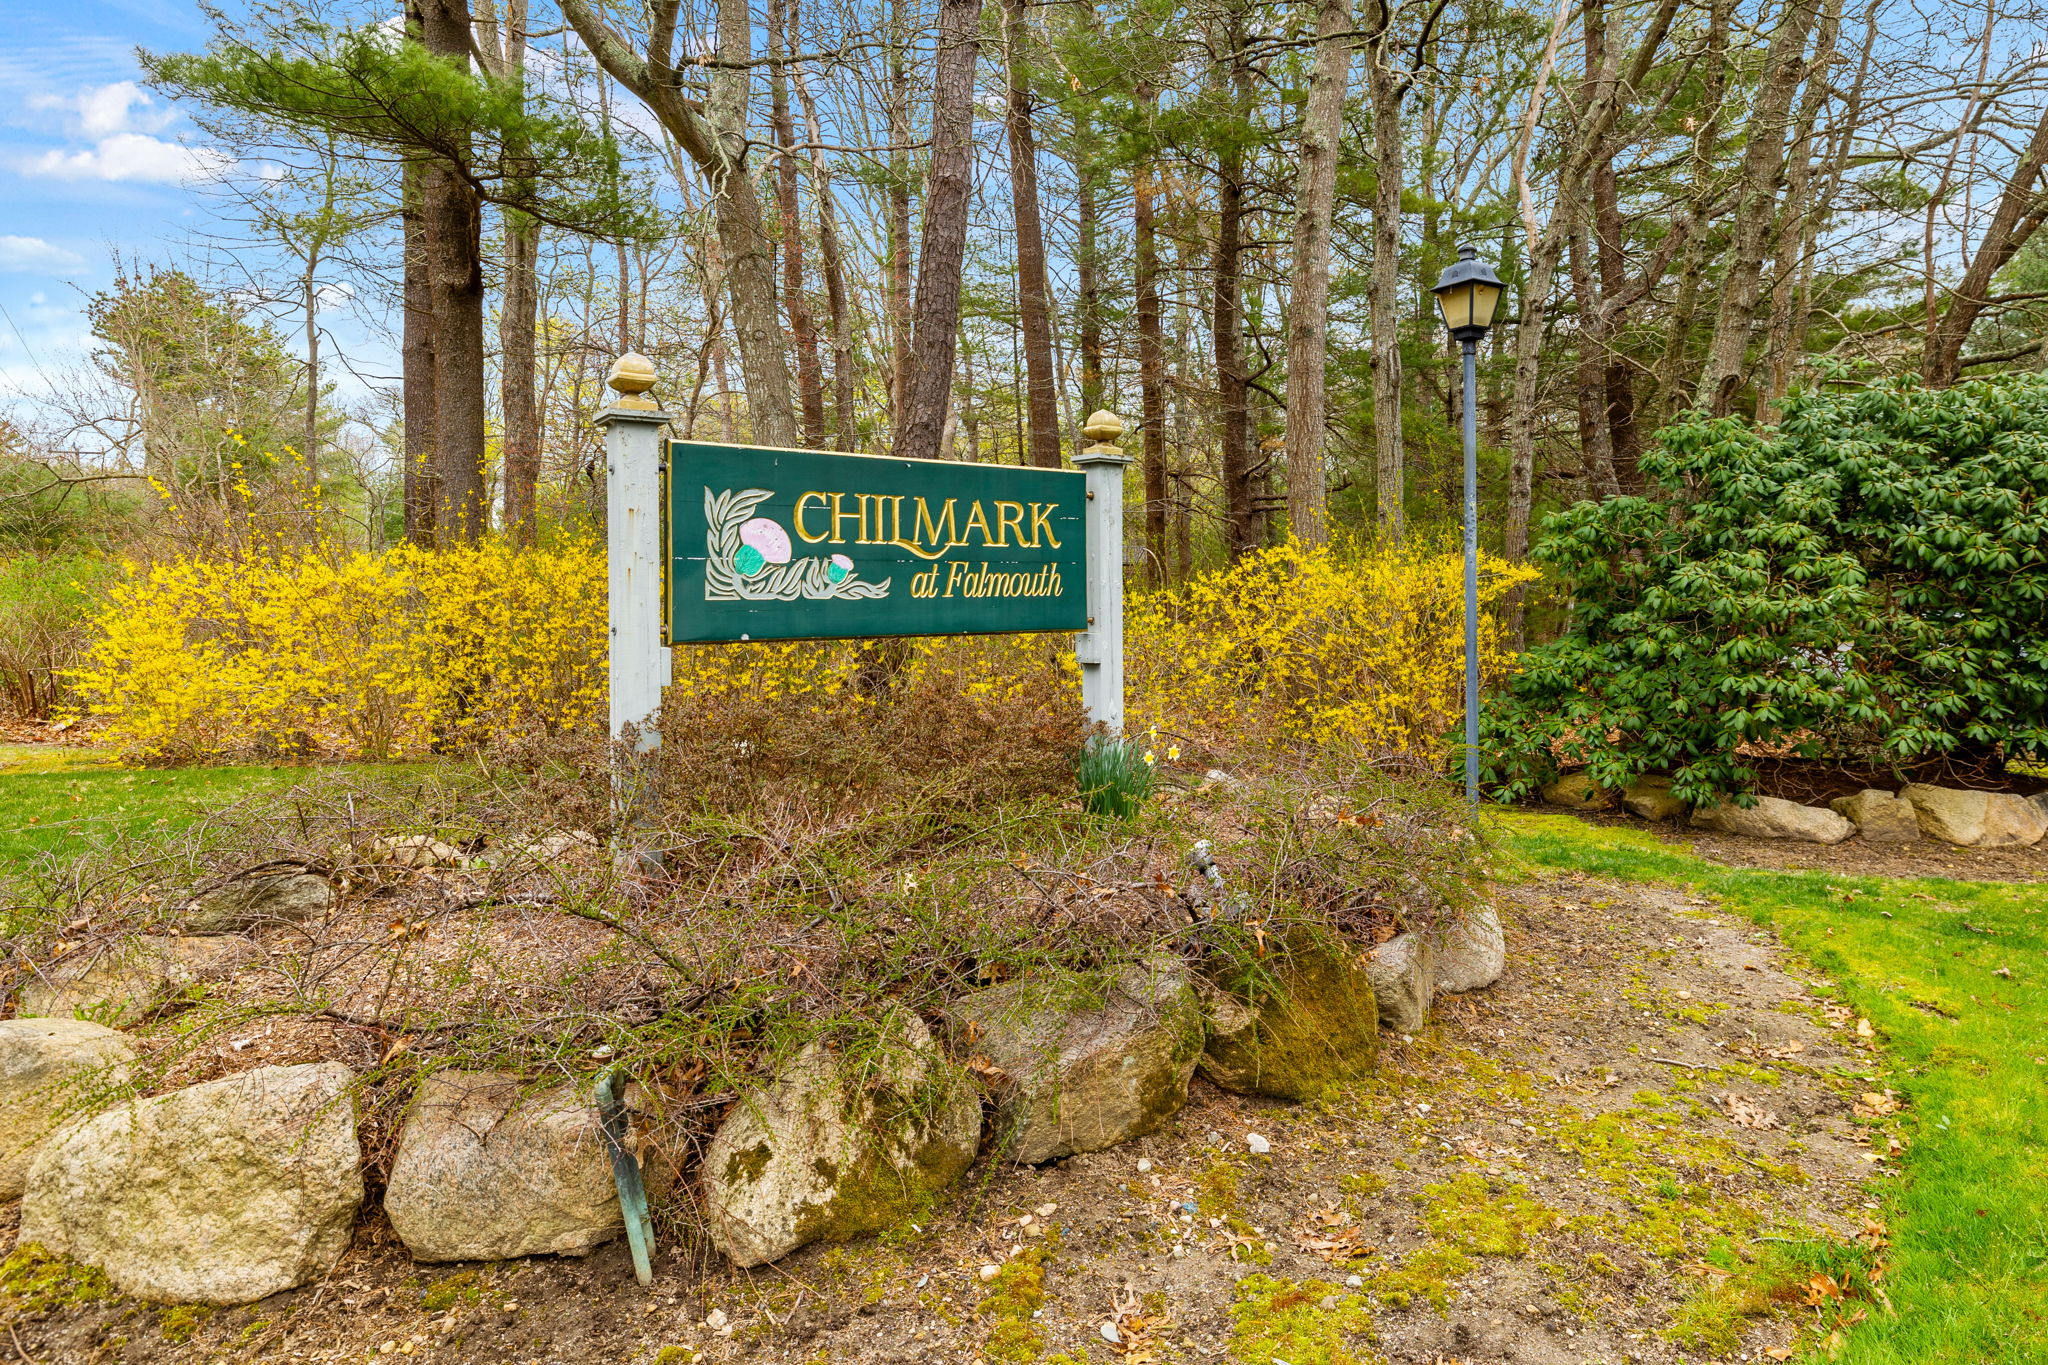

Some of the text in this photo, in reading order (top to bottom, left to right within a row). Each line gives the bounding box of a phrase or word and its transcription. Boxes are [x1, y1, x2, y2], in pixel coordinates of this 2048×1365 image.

[793, 490, 1062, 560] CHILMARK
[910, 561, 1063, 598] at Falmouth
